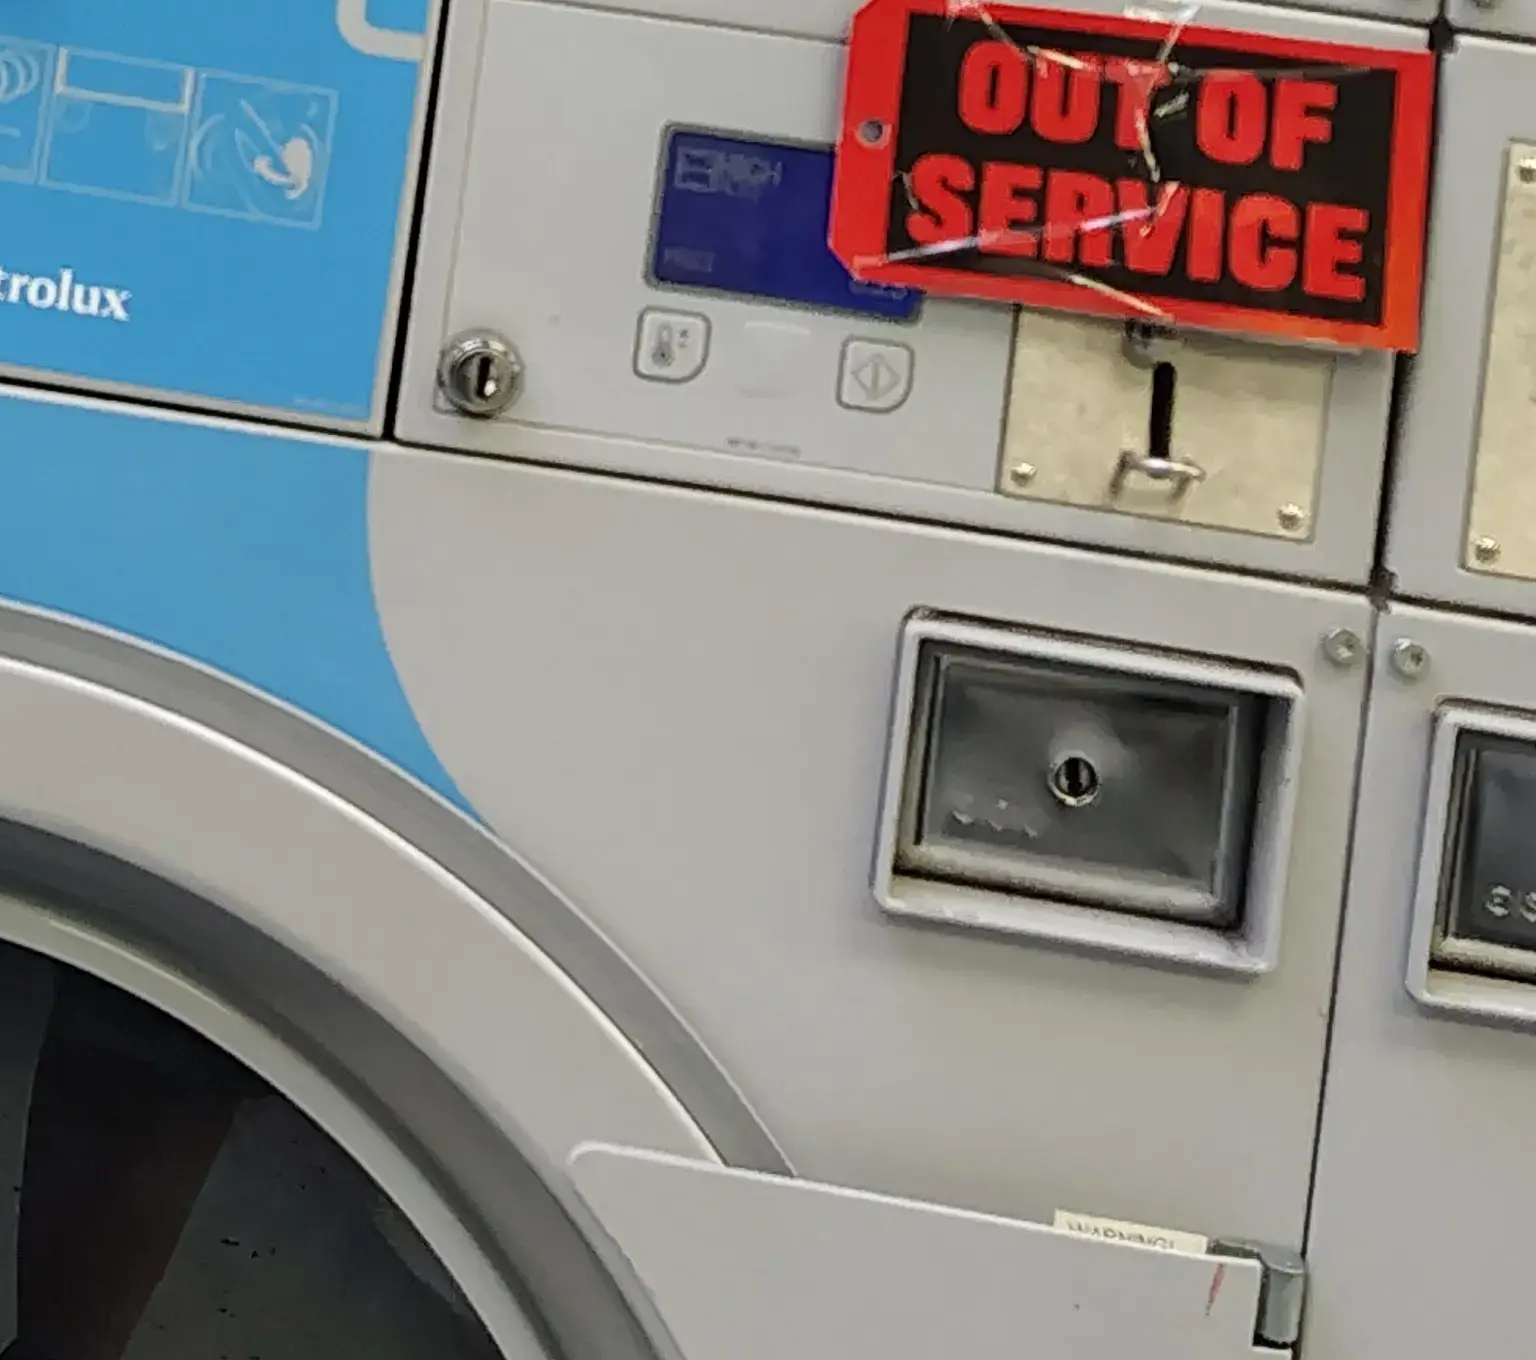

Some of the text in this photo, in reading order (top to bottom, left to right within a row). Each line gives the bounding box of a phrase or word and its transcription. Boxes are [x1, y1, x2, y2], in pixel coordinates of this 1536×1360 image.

[958, 40, 1339, 171] OUT OF
[904, 152, 1370, 302] SERVICE
